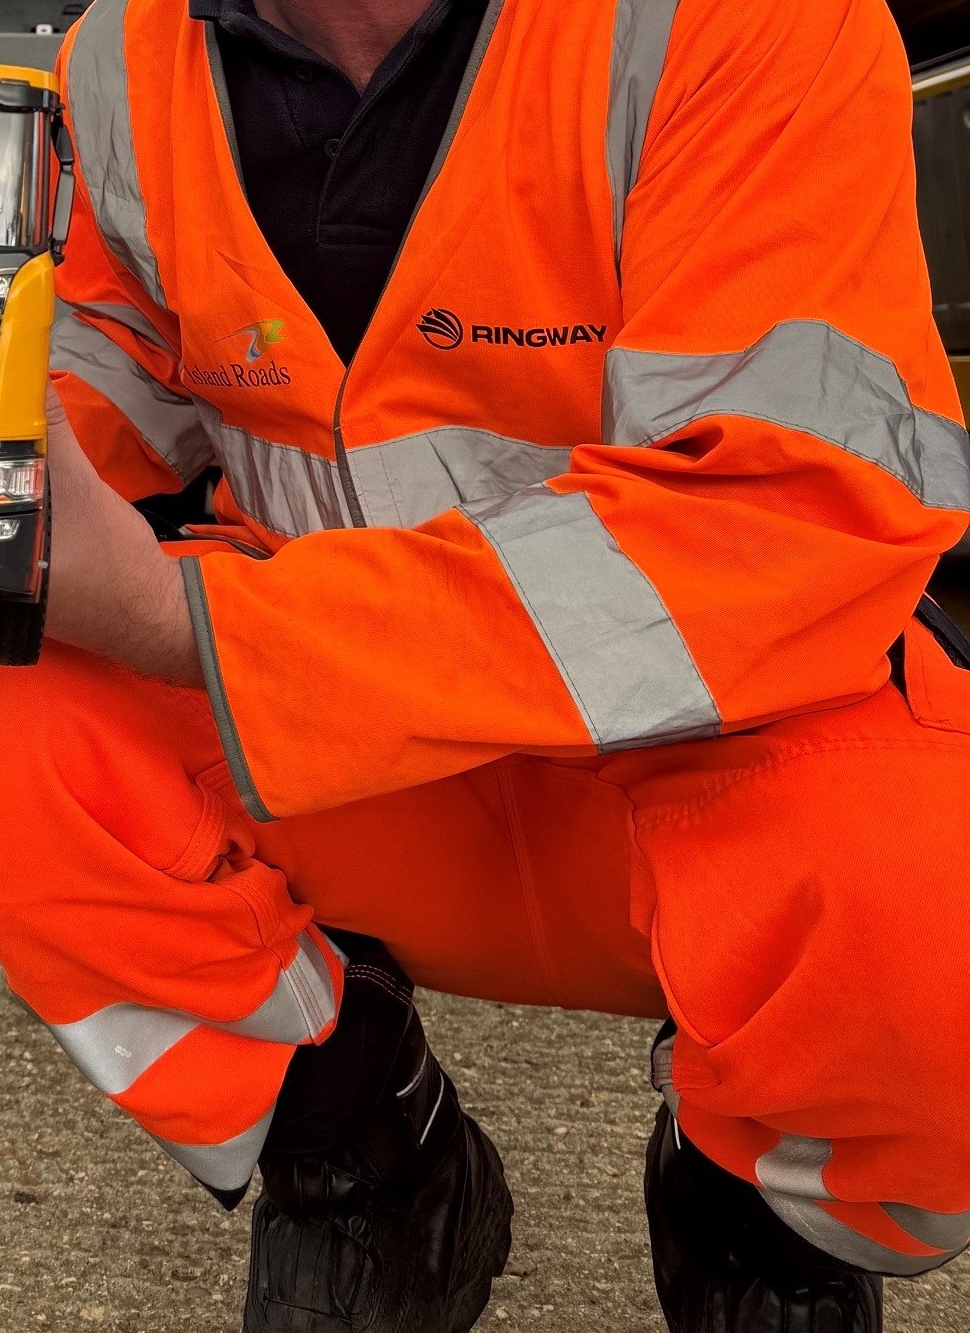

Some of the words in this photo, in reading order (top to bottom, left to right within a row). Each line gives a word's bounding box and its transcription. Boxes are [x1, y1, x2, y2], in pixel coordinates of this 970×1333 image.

[471, 324, 607, 348] RINGWAY
[184, 364, 233, 387] Island
[230, 360, 291, 387] Roads
